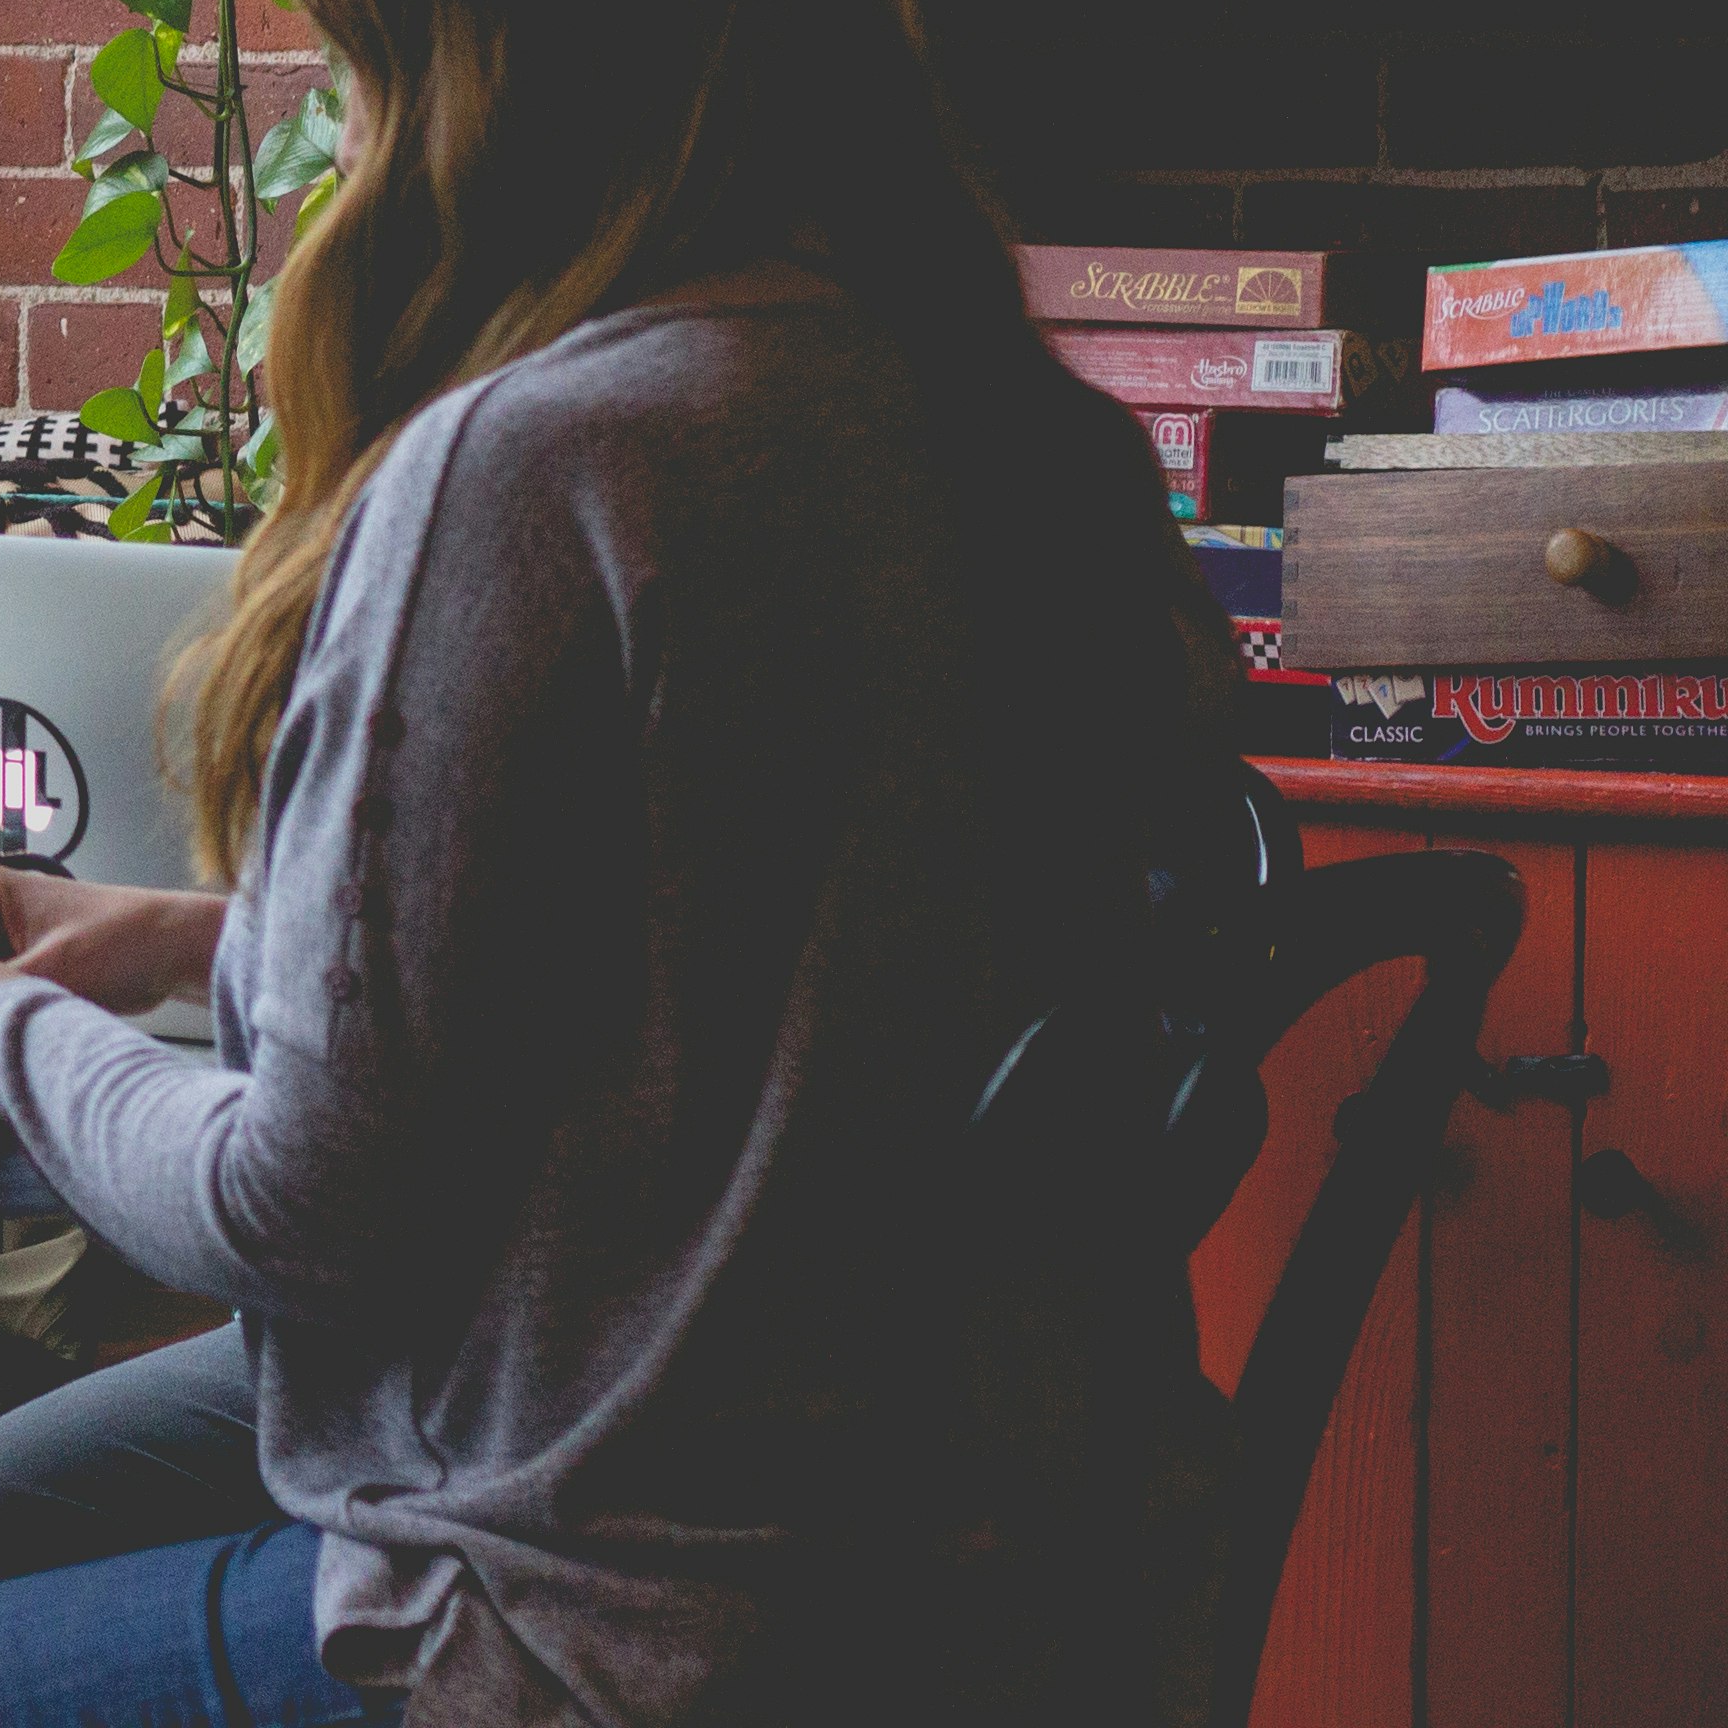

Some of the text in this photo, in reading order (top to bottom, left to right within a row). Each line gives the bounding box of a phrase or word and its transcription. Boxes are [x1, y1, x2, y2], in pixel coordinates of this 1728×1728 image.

[1192, 357, 1245, 377] Hasbro
[1478, 394, 1685, 434] SCATTERGORIES
[1432, 673, 1728, 745] Rummiku
[1349, 725, 1424, 744] CLASSIC
[1524, 723, 1728, 738] BRINGS PEOPLE TOGETHE
